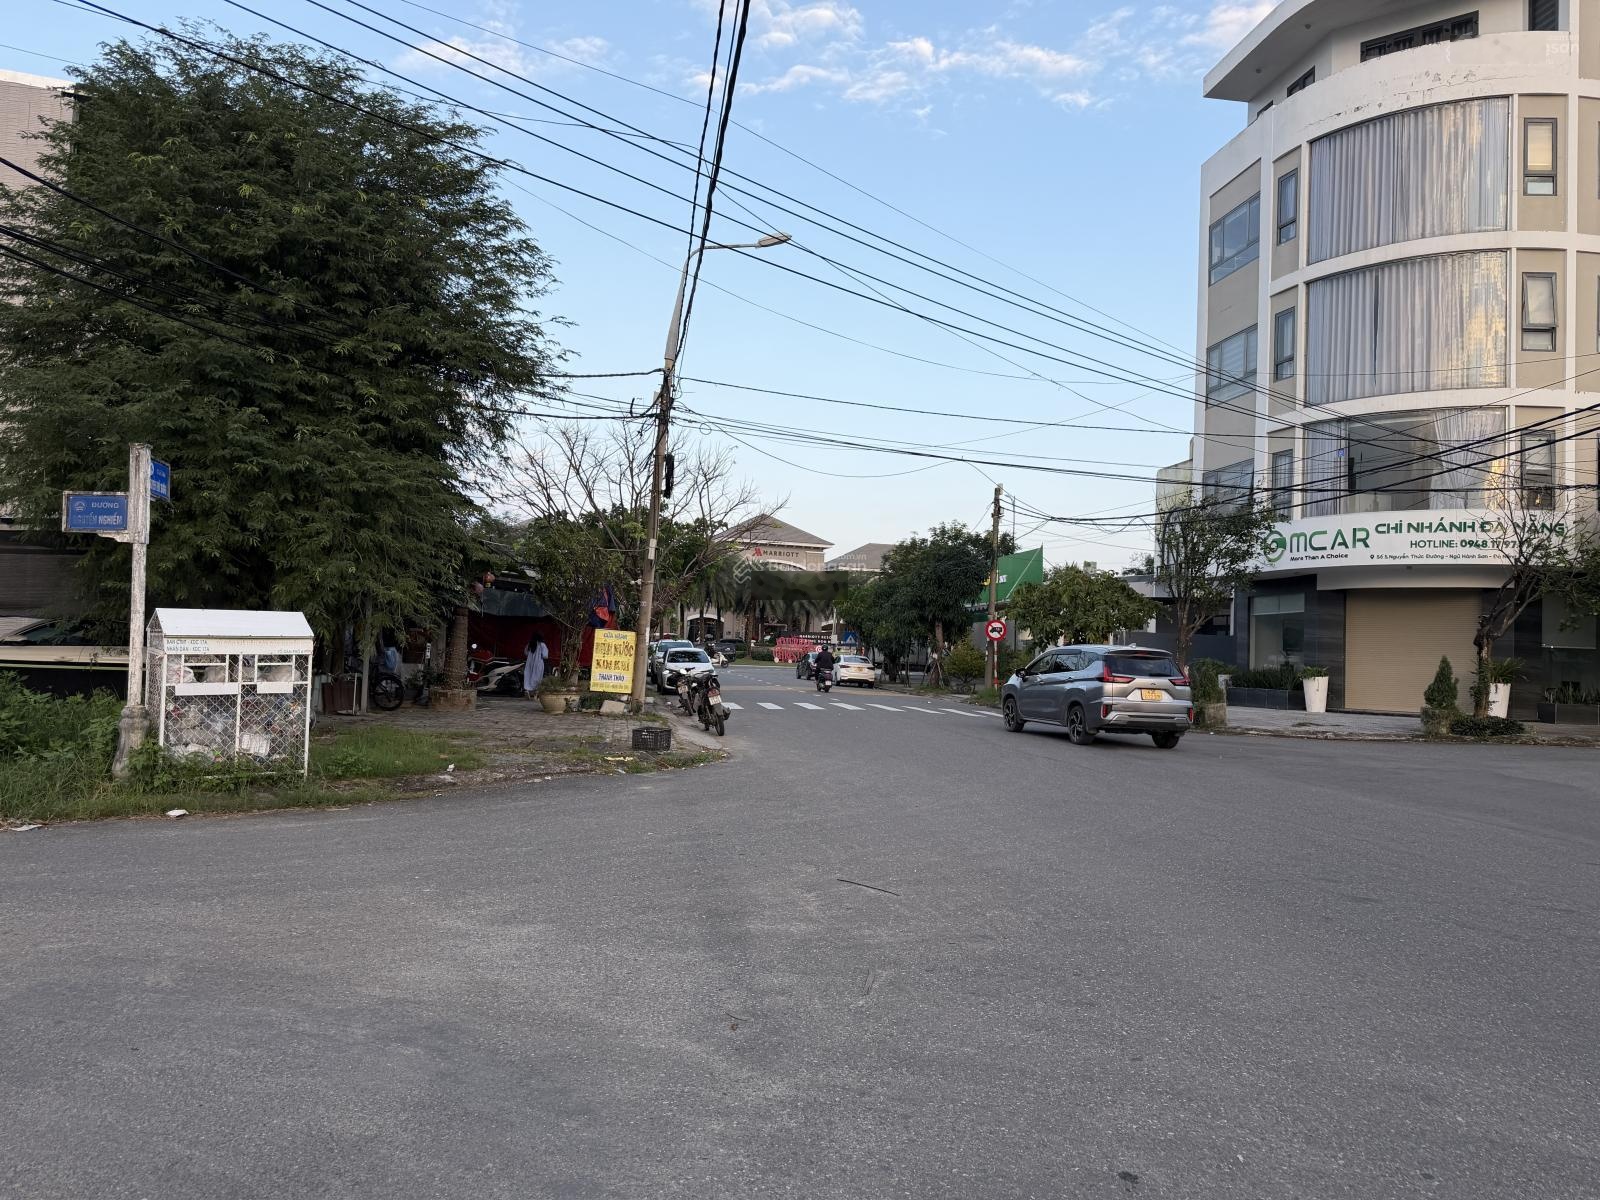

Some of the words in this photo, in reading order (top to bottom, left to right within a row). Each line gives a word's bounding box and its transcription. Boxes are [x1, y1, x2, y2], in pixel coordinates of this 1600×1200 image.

[1407, 516, 1476, 534] NHÁNH
[1410, 539, 1458, 549] HOTLINE:
[763, 550, 800, 558] MARRIOTT
[1326, 552, 1349, 560] Choice
